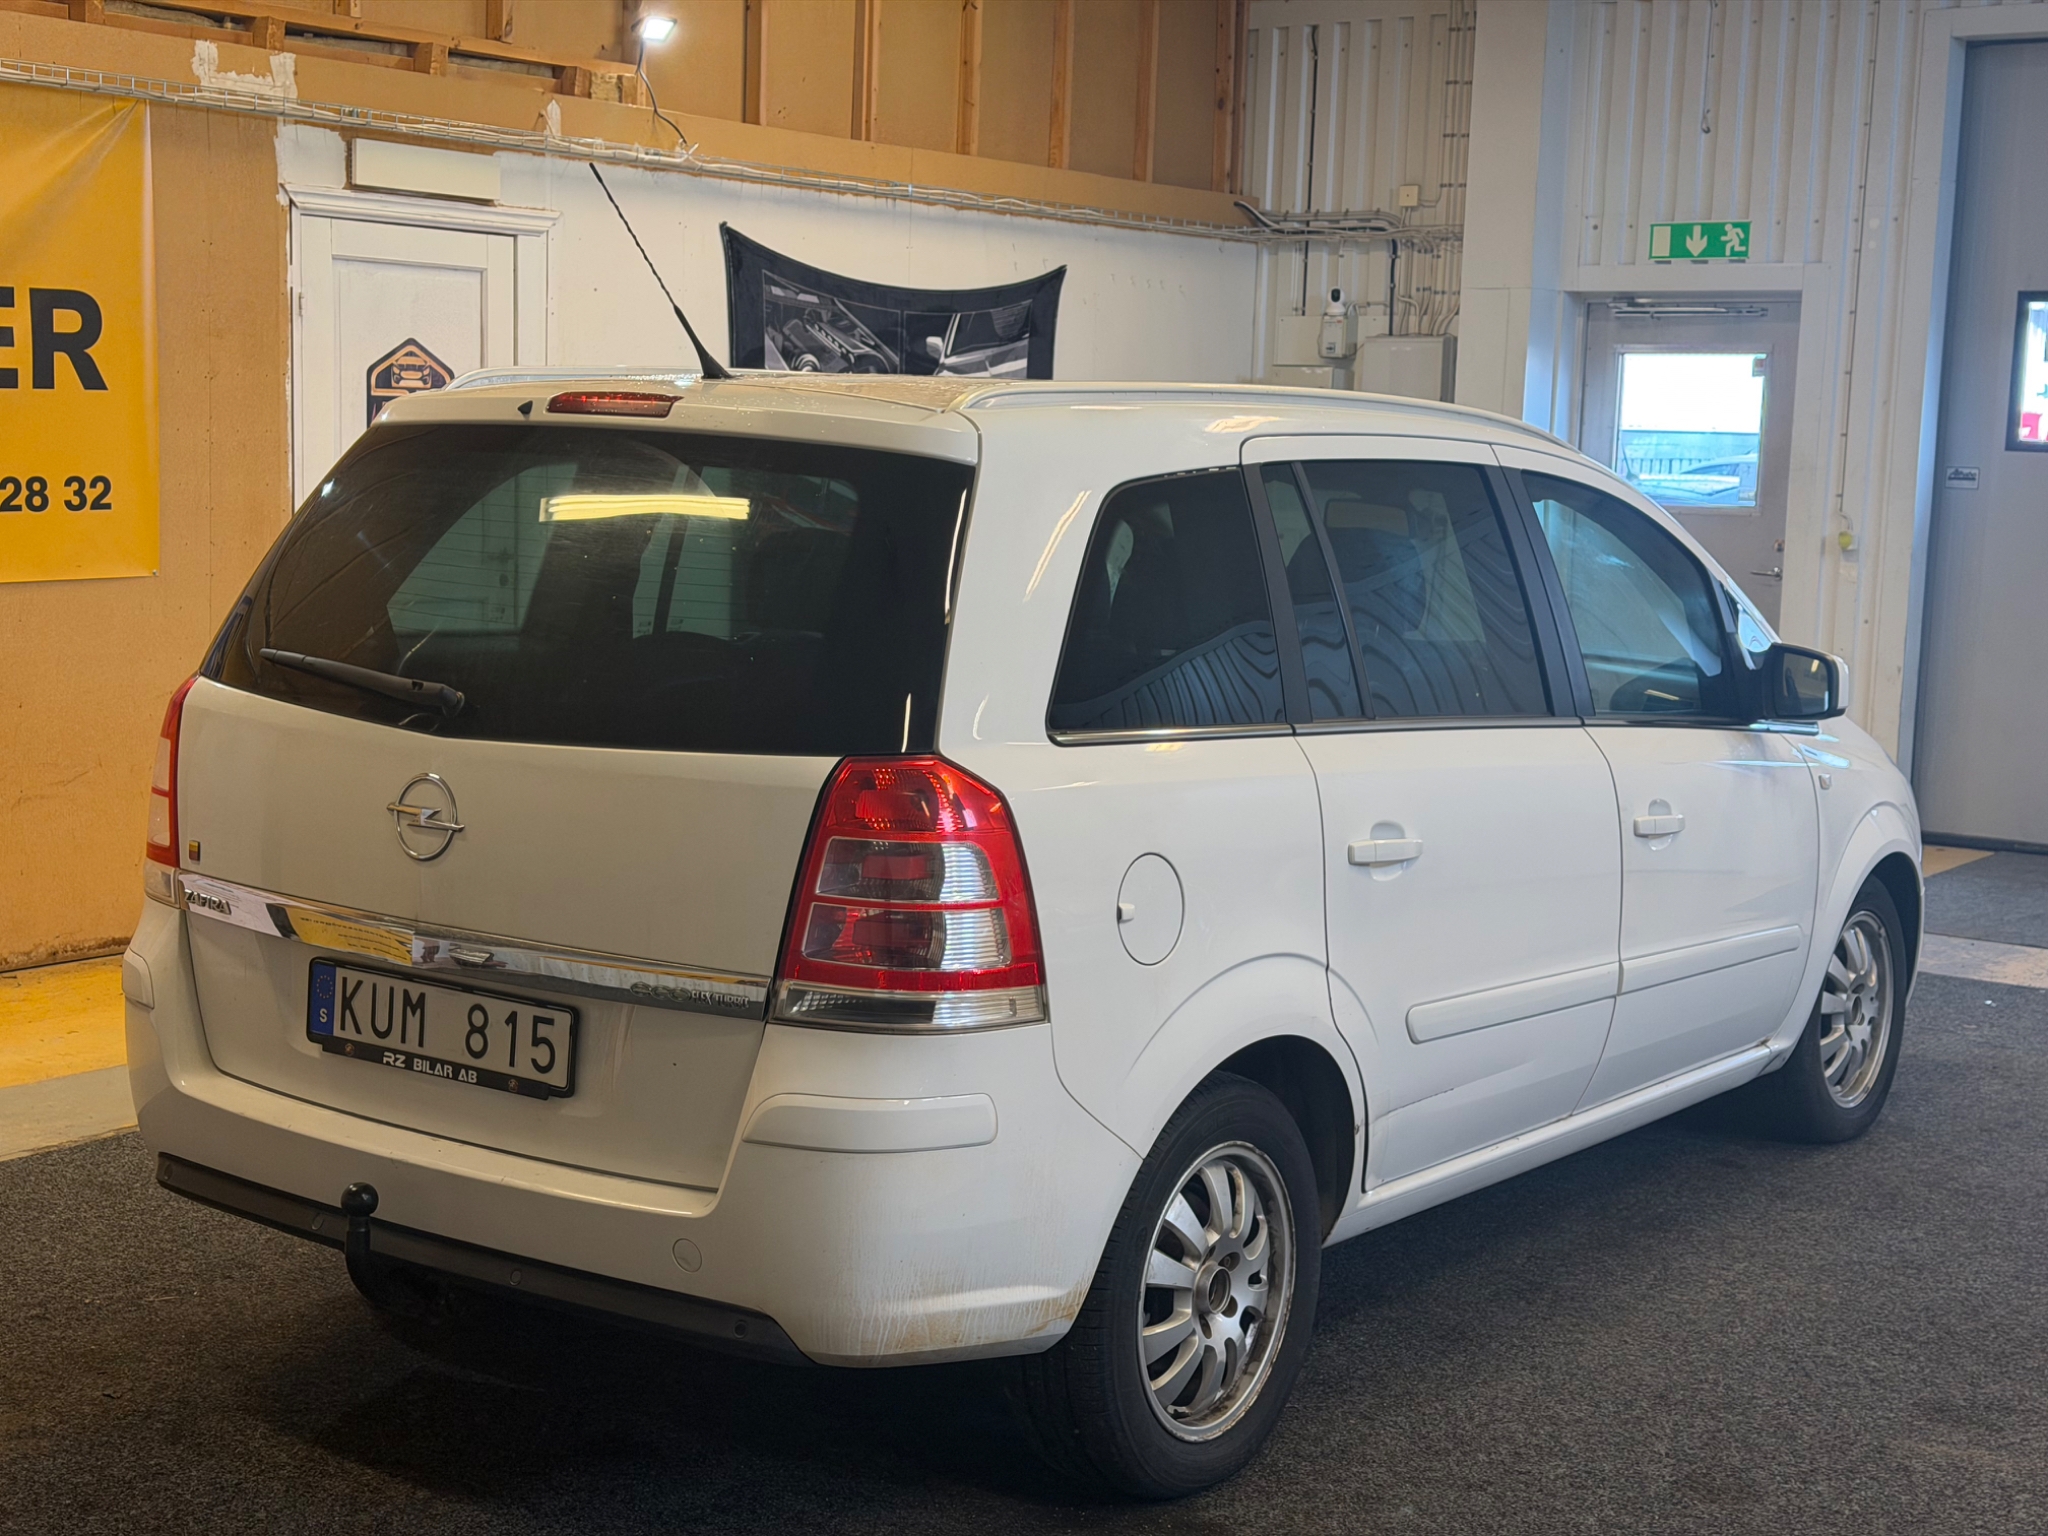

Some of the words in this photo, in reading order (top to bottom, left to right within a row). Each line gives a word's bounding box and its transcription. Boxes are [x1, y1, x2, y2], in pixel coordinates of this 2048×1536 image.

[0, 476, 50, 513] 28
[63, 475, 112, 512] 32
[184, 889, 232, 915] ZAFIRA
[319, 1008, 328, 1023] S
[340, 976, 426, 1048] KUM
[465, 1003, 556, 1074] 815
[382, 1051, 406, 1068] RZ
[413, 1058, 453, 1078] BILAR
[457, 1068, 478, 1083] AB
